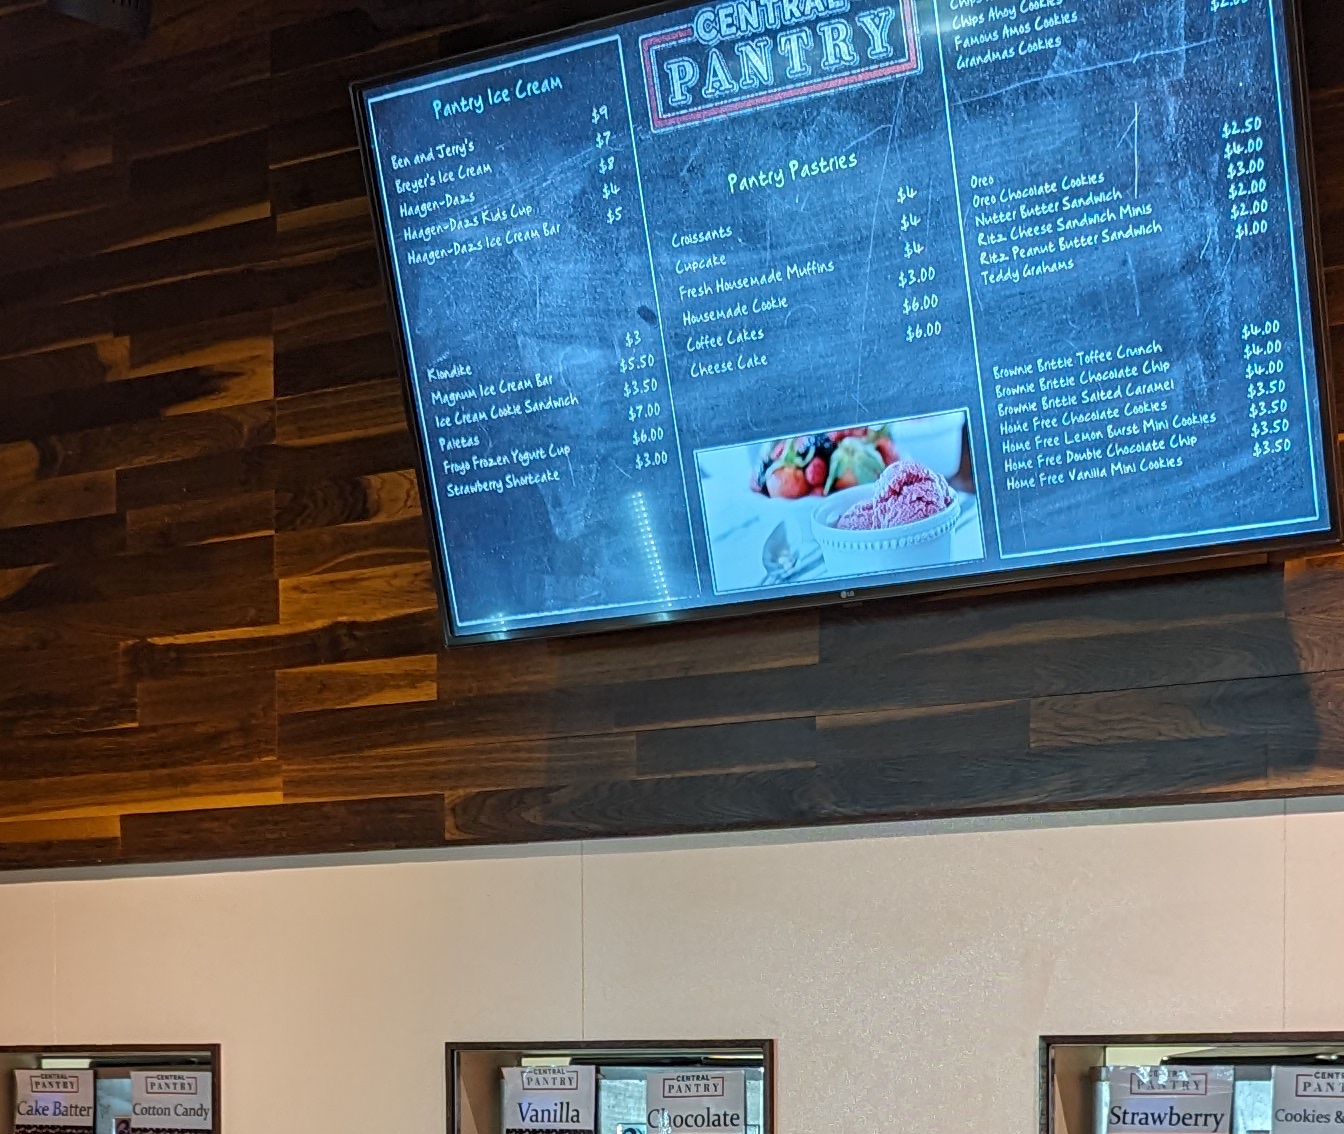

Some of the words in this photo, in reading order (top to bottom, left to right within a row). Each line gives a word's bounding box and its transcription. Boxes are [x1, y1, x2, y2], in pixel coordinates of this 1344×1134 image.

[664, 7, 895, 105] PANTRY
[956, 49, 1015, 71] Grandmas
[1018, 36, 1062, 56] Cookies
[432, 95, 485, 120] Pantry
[488, 88, 510, 105] Ice
[515, 76, 563, 98] Cream
[390, 155, 411, 170] Ben
[414, 149, 435, 165] and
[436, 139, 474, 159] Jerry's
[591, 105, 608, 124] $9
[971, 175, 994, 188] Oreo
[1222, 116, 1261, 139] $2.50
[399, 192, 475, 218] Haagen-Dazs
[599, 157, 614, 174] $8
[728, 170, 785, 194] Pantry
[789, 153, 857, 180] Pastries
[973, 194, 996, 208] Oreo
[1000, 182, 1057, 203] Chocolate
[1061, 173, 1105, 190] Cookies
[1224, 137, 1263, 158] $4.00
[978, 232, 1006, 247] Ritz
[1010, 224, 1053, 241] Cheese
[1056, 210, 1116, 231] Sandwich
[1119, 204, 1153, 220] Minis
[1229, 180, 1266, 200] $2.00
[672, 226, 733, 248] Croissants
[981, 270, 1019, 286] Teddy
[1235, 220, 1268, 240] $1.00
[675, 254, 727, 275] Cupcake
[679, 285, 713, 301] Fresh
[716, 269, 783, 294] Housemade
[787, 260, 835, 280] Muffins
[683, 303, 749, 326] Housemade
[752, 296, 788, 313] Cookie
[899, 267, 936, 288] $3.00
[687, 337, 723, 352] Coffee
[727, 328, 764, 345] Cakes
[903, 294, 938, 315] $6.00
[427, 365, 472, 382] Klondike
[626, 331, 641, 348] $3
[690, 362, 734, 378] Cheese
[737, 354, 768, 370] Cake
[906, 321, 942, 342] $6.00
[993, 364, 1033, 380] Brownie
[1037, 357, 1073, 372] Brittle
[1076, 350, 1113, 366] Toffee
[1117, 341, 1162, 360] Crunch
[1242, 320, 1280, 339] $4.00
[435, 415, 452, 428] Ice
[455, 411, 487, 425] Cream
[490, 403, 521, 418] Cookie
[525, 393, 579, 412] Sandwich
[624, 379, 657, 397] $3.50
[439, 435, 480, 451] Paletas
[628, 403, 660, 422] $7.00
[1002, 440, 1032, 454] Home
[1035, 435, 1060, 449] Free
[1064, 429, 1103, 445] Lemon
[1107, 423, 1140, 439] Burst
[1143, 419, 1169, 431] Mini
[1172, 412, 1216, 428] Cookies
[1250, 400, 1287, 418] $3.50
[447, 476, 503, 497] Strawberry
[506, 471, 560, 489] Shortcake
[636, 451, 668, 470] $3.00
[34, 1081, 76, 1090] PANTRY
[150, 1082, 193, 1091] PANTRY
[527, 1076, 574, 1087] PANTRY
[668, 1083, 720, 1093] PANTRY
[17, 1101, 49, 1117] Cake
[52, 1101, 92, 1117] Batter
[132, 1103, 171, 1116] Cotton
[174, 1104, 210, 1119] Candy
[517, 1101, 581, 1123] Vanilla
[648, 1107, 740, 1128] Chocolate
[1109, 1106, 1225, 1133] Strawberry
[1275, 1109, 1330, 1123] Cookies
[1335, 1111, 1344, 1123] &
